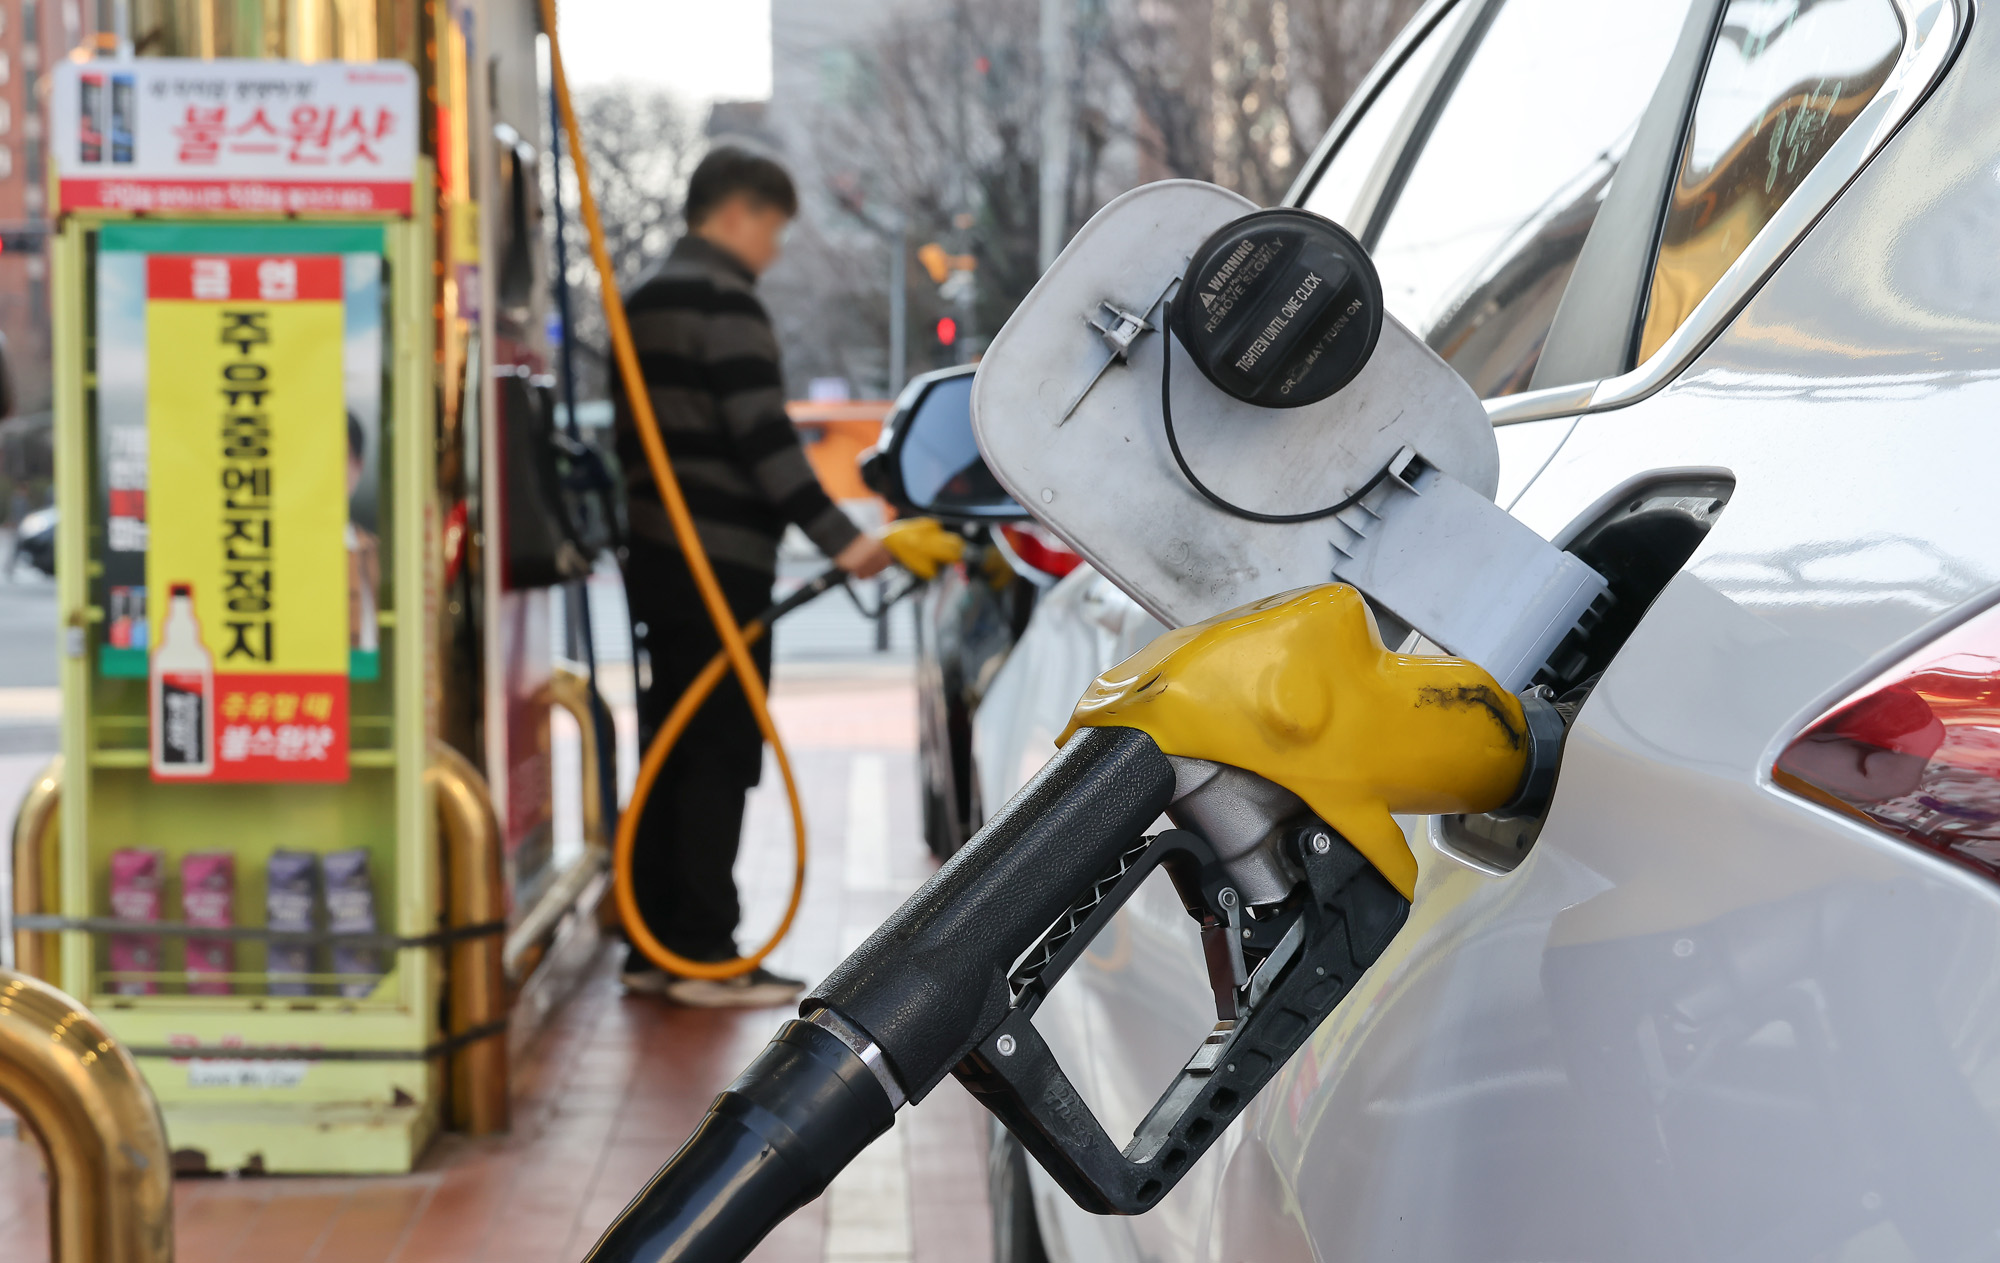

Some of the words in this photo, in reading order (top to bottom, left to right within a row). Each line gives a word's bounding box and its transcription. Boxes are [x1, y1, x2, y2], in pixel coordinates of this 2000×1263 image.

[173, 104, 398, 165] 불스원샷
[1204, 285, 1246, 333] REMOVE
[1243, 237, 1283, 285] SLOWLY
[1208, 239, 1255, 291] WARNING
[1235, 336, 1270, 372] TIGHTEN
[1262, 316, 1289, 341] UNTIL
[1281, 296, 1303, 318] ONE
[1295, 272, 1322, 301] CLICK
[1280, 378, 1296, 394] OR
[1305, 341, 1325, 365] MAY
[1323, 314, 1349, 342] TURN
[1346, 298, 1363, 315] ON
[220, 310, 272, 663] 주유중엔진정지
[219, 724, 335, 761] 불스원샷
